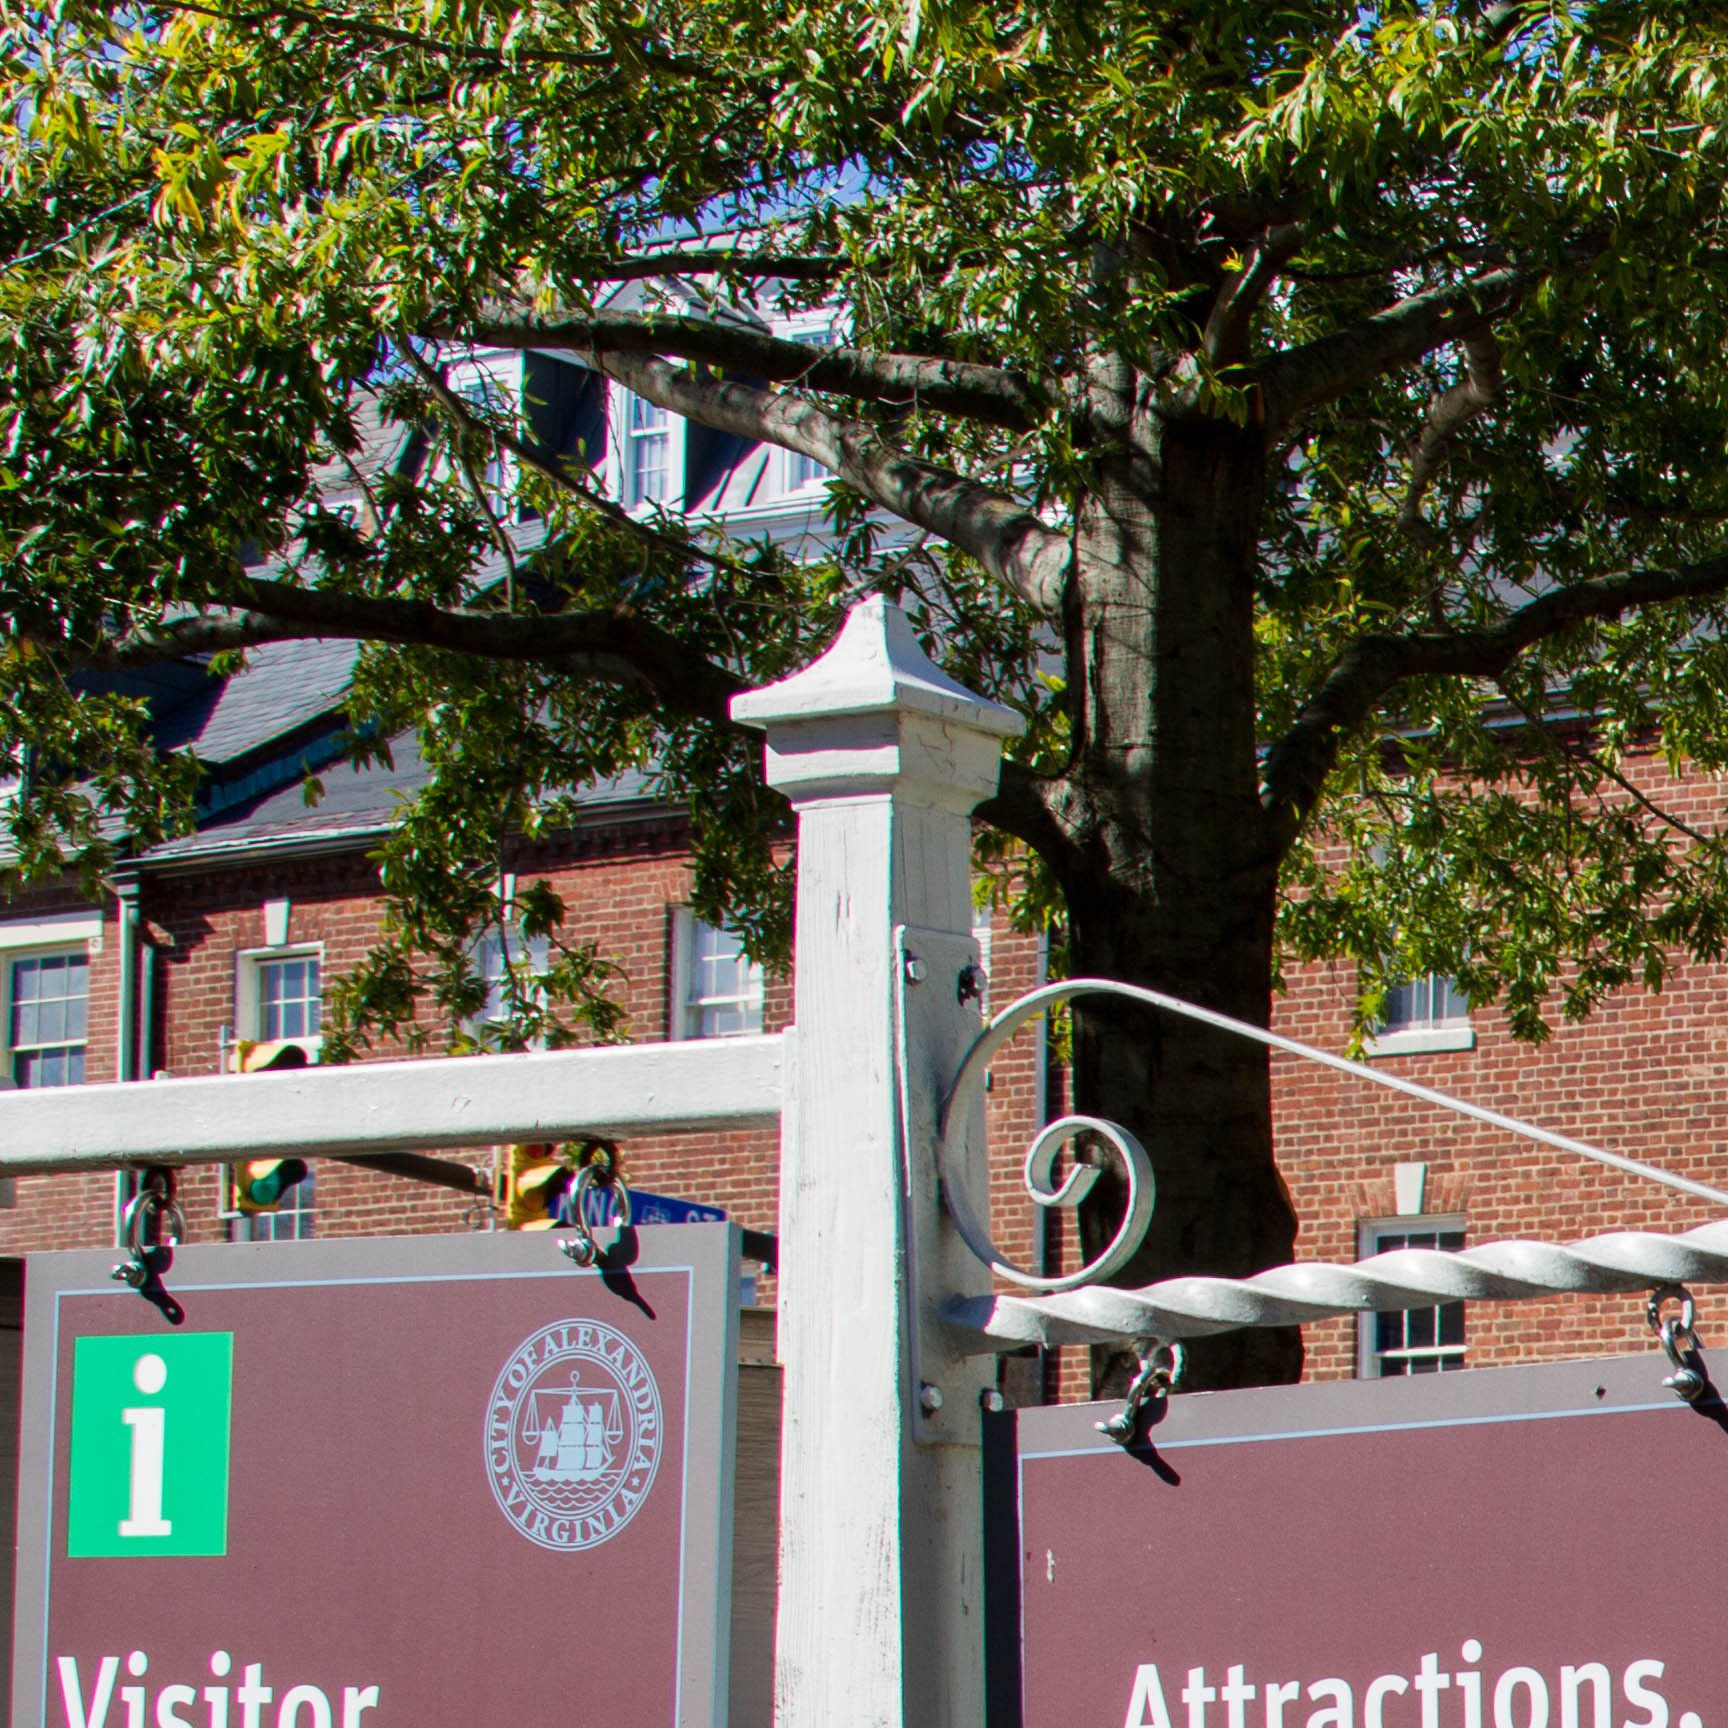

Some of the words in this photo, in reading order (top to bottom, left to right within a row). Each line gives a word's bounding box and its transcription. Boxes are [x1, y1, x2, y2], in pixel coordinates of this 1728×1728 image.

[491, 1389, 514, 1474] CITY
[508, 1347, 539, 1389] OF
[543, 1327, 657, 1471] ALEXANDRIA
[504, 1480, 640, 1543] VIRGINIA
